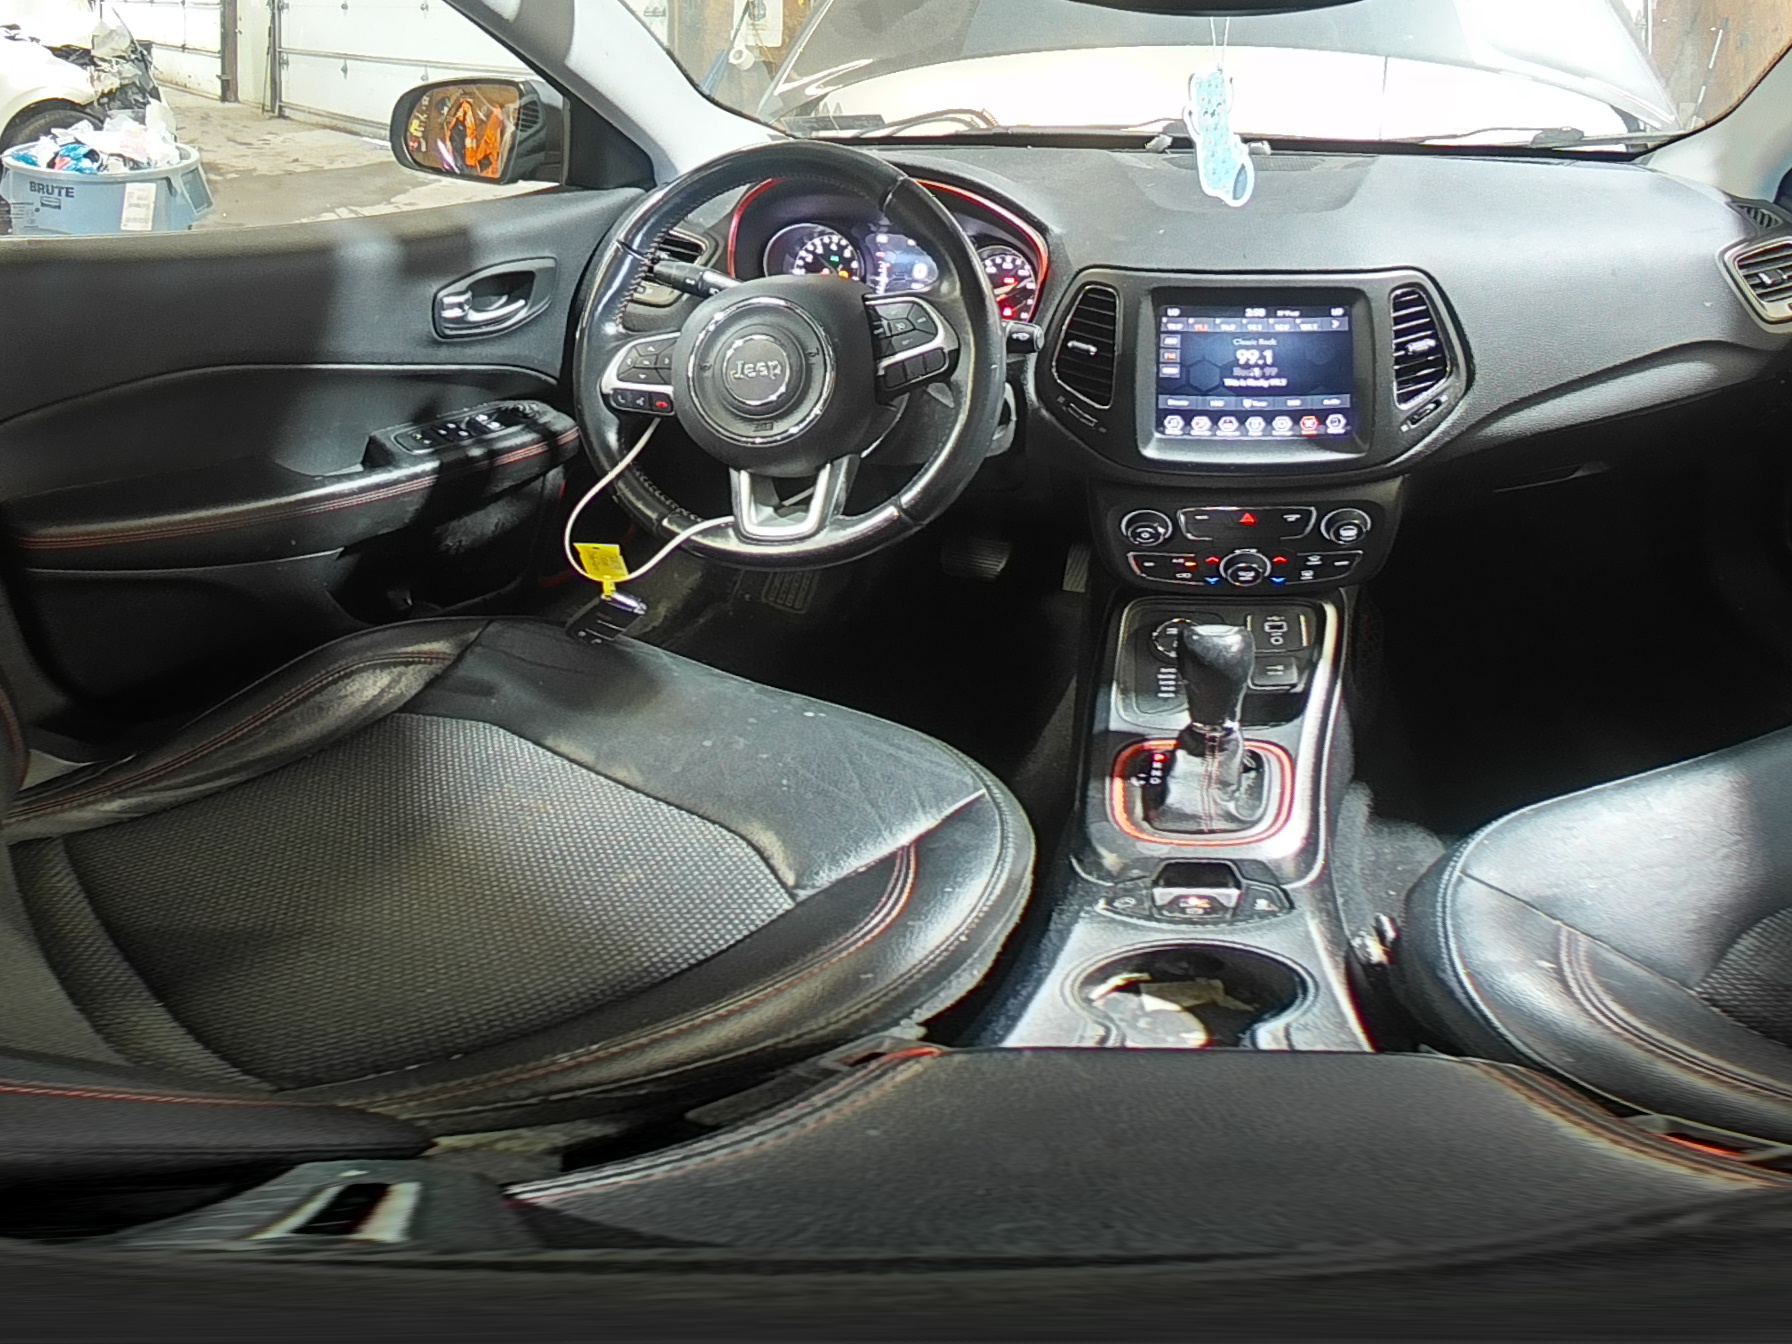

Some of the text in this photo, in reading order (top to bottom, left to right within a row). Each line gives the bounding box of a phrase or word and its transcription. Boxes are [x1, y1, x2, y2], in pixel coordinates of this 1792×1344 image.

[29, 181, 75, 198] BRUTE
[1236, 349, 1273, 365] 99.1
[730, 360, 781, 379] Jeep
